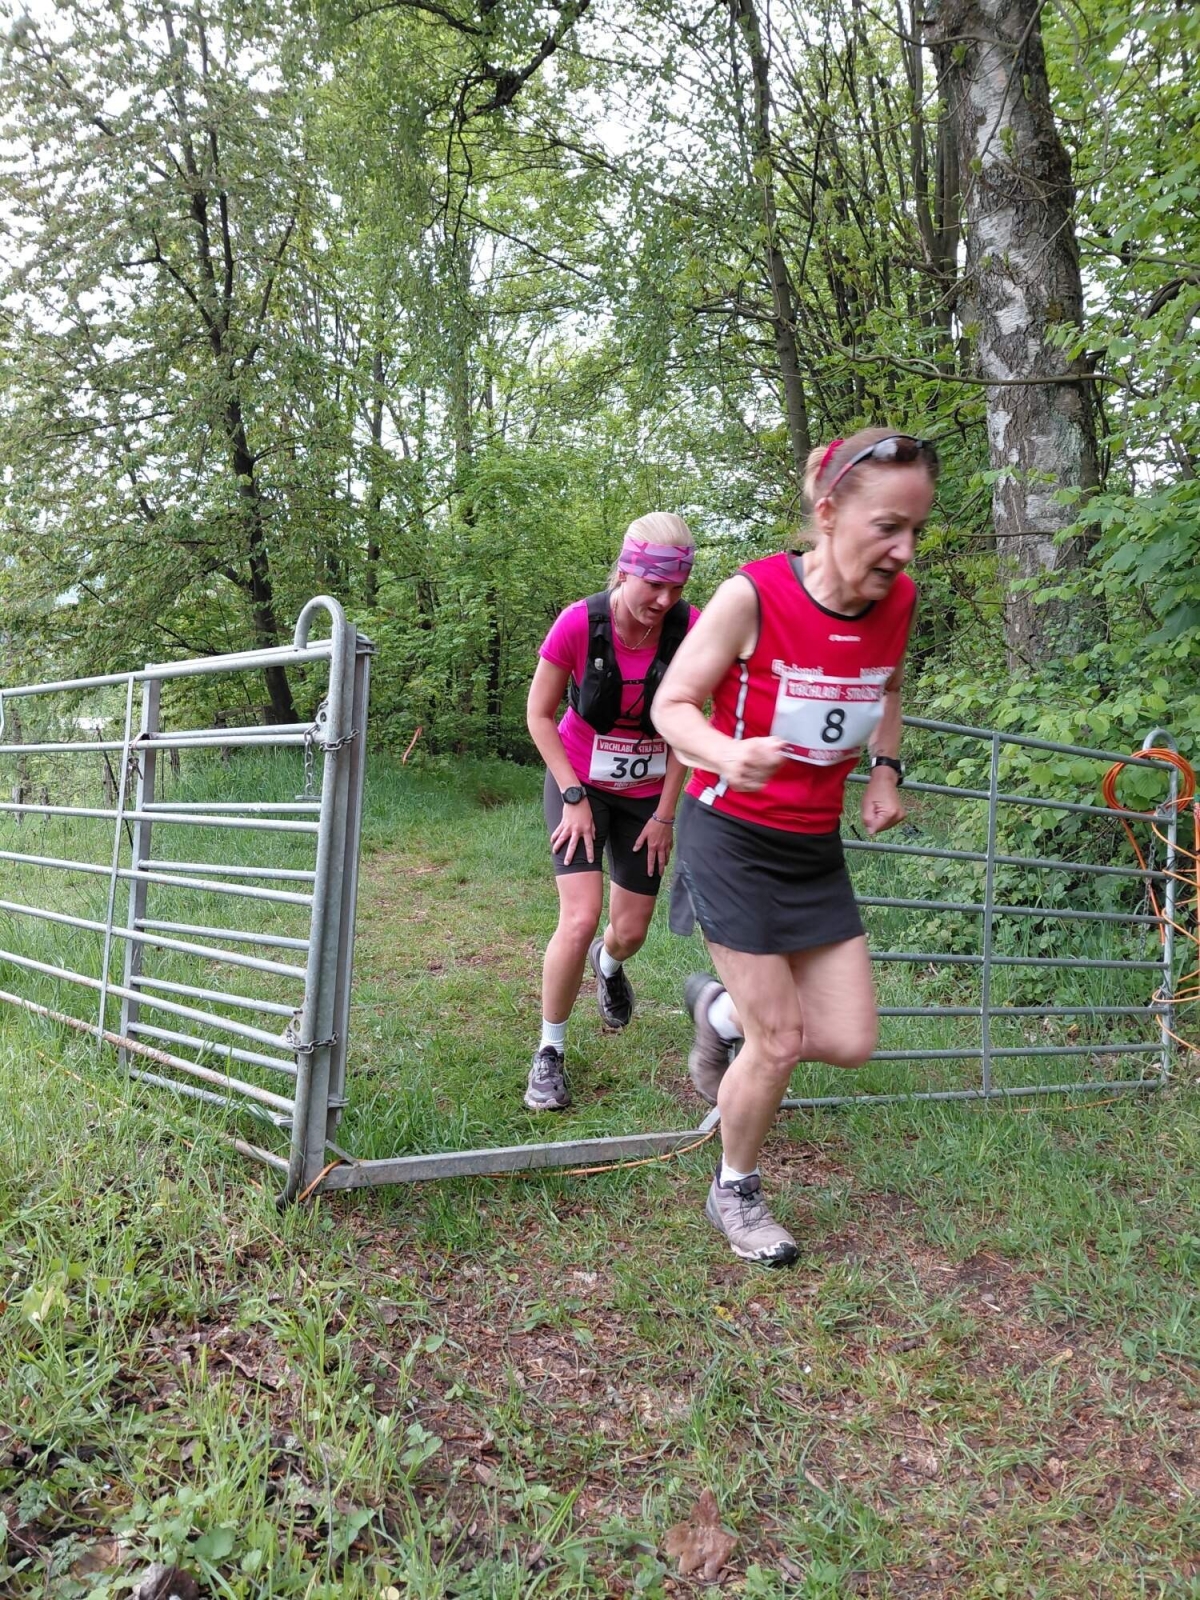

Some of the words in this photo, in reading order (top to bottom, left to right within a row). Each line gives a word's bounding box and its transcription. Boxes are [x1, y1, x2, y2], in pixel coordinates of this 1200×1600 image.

[822, 708, 845, 743] 8
[599, 742, 633, 753] VRCHLABÍ
[610, 756, 649, 780] 30
